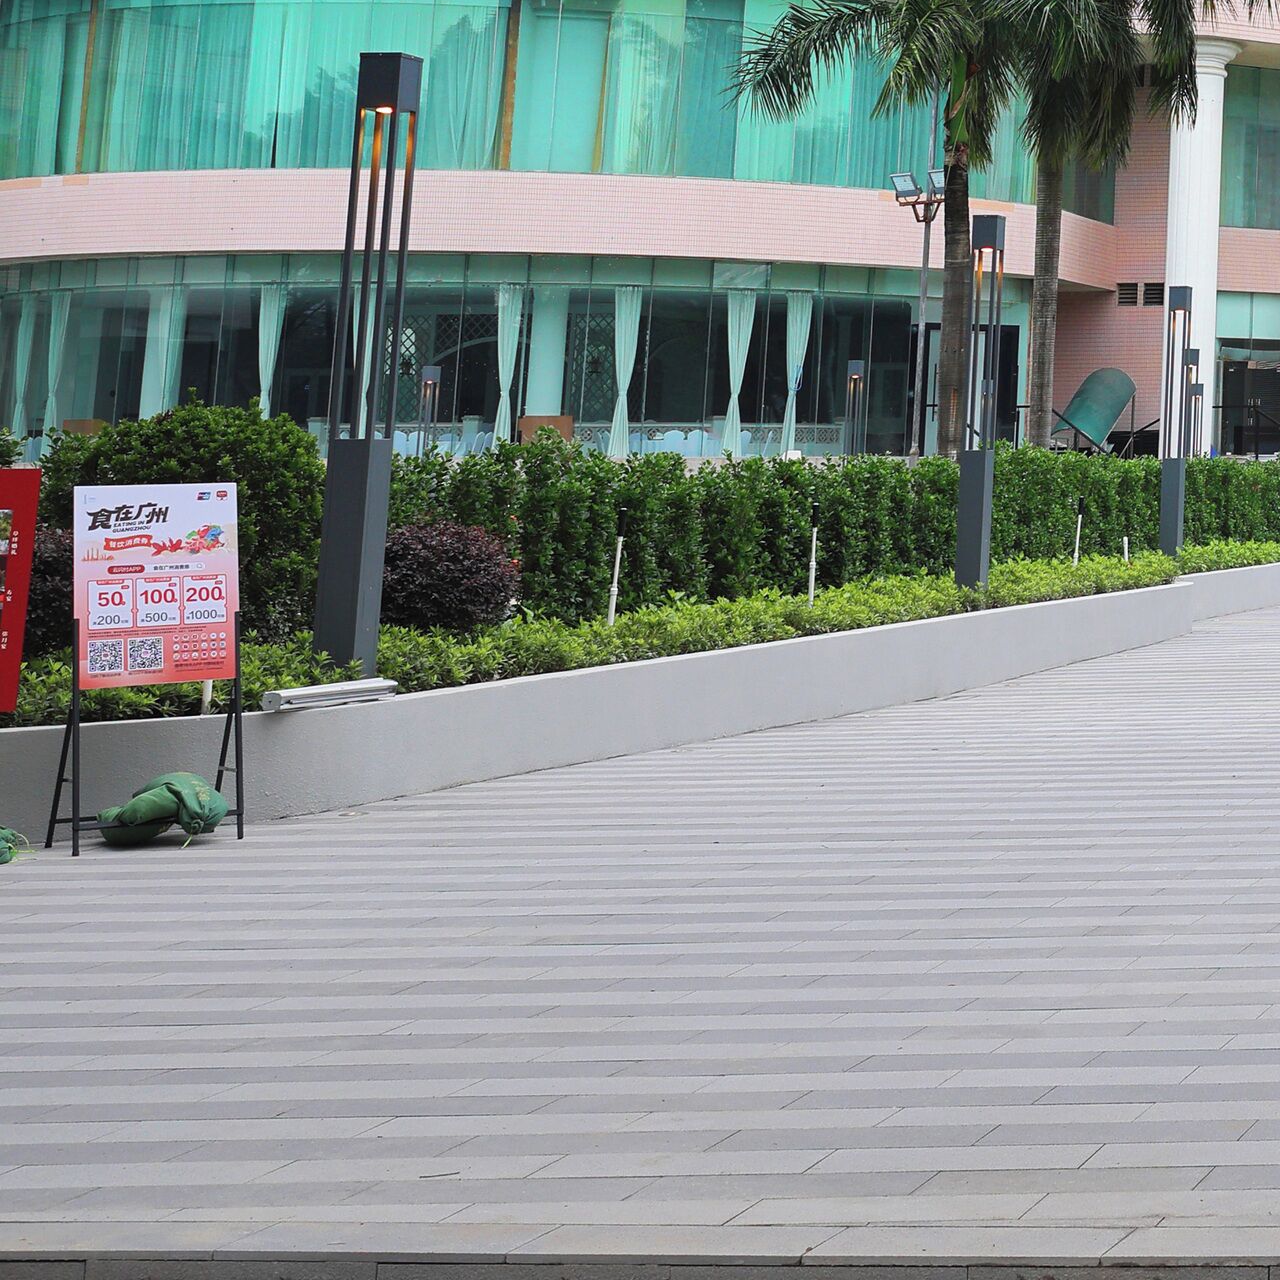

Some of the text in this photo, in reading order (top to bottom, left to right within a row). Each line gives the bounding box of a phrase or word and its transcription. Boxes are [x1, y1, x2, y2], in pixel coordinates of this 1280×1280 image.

[87, 502, 169, 531] 食在广州
[112, 525, 152, 533] GUANGZHOU
